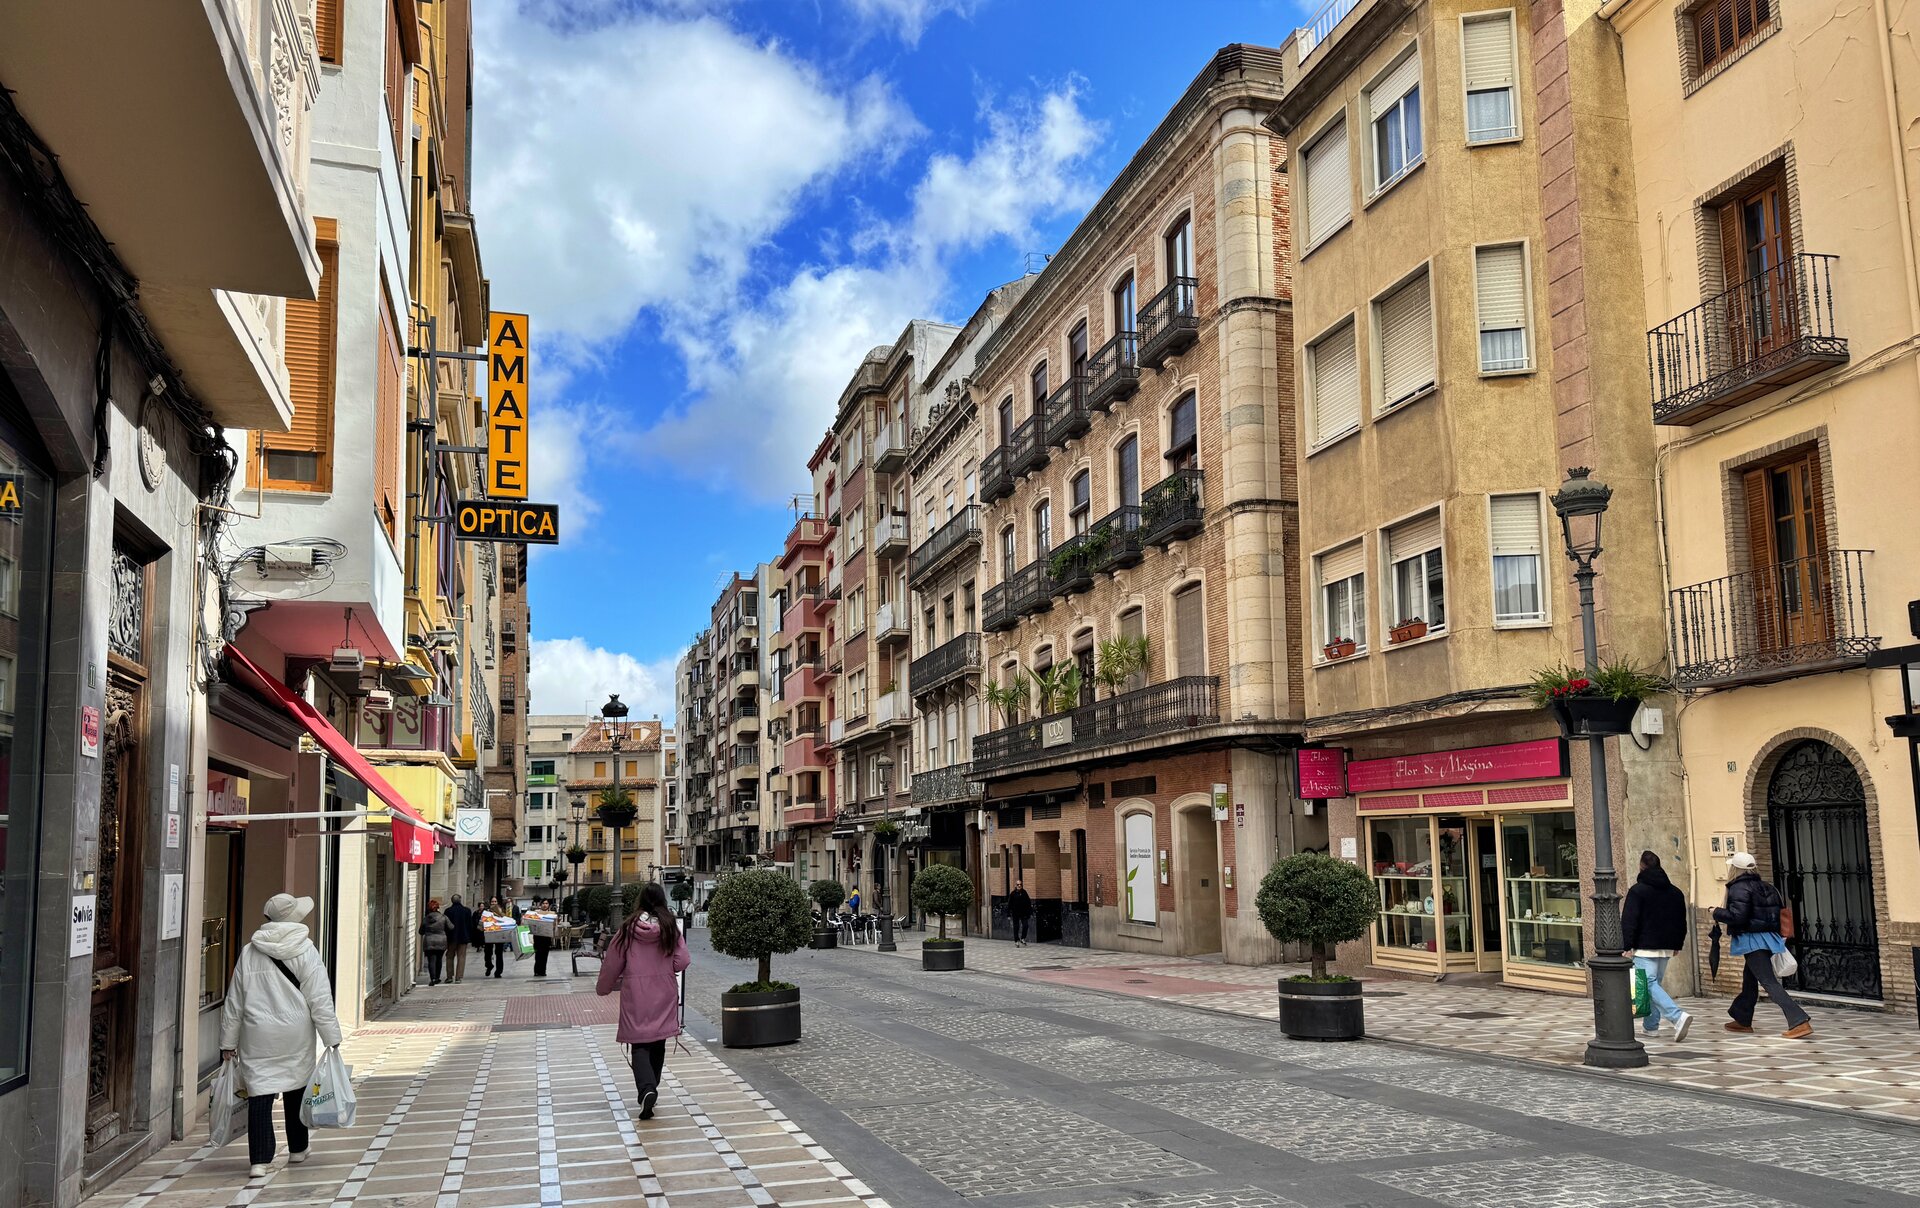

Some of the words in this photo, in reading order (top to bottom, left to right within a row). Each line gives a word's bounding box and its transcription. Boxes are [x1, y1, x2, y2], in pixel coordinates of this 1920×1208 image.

[492, 319, 525, 490] AMATE
[459, 507, 556, 536] OPTICA
[1310, 751, 1330, 762] Flor
[1396, 759, 1418, 778] Flor
[1423, 763, 1434, 775] de
[1440, 754, 1494, 781] Mágina
[72, 905, 93, 924] Solvia
